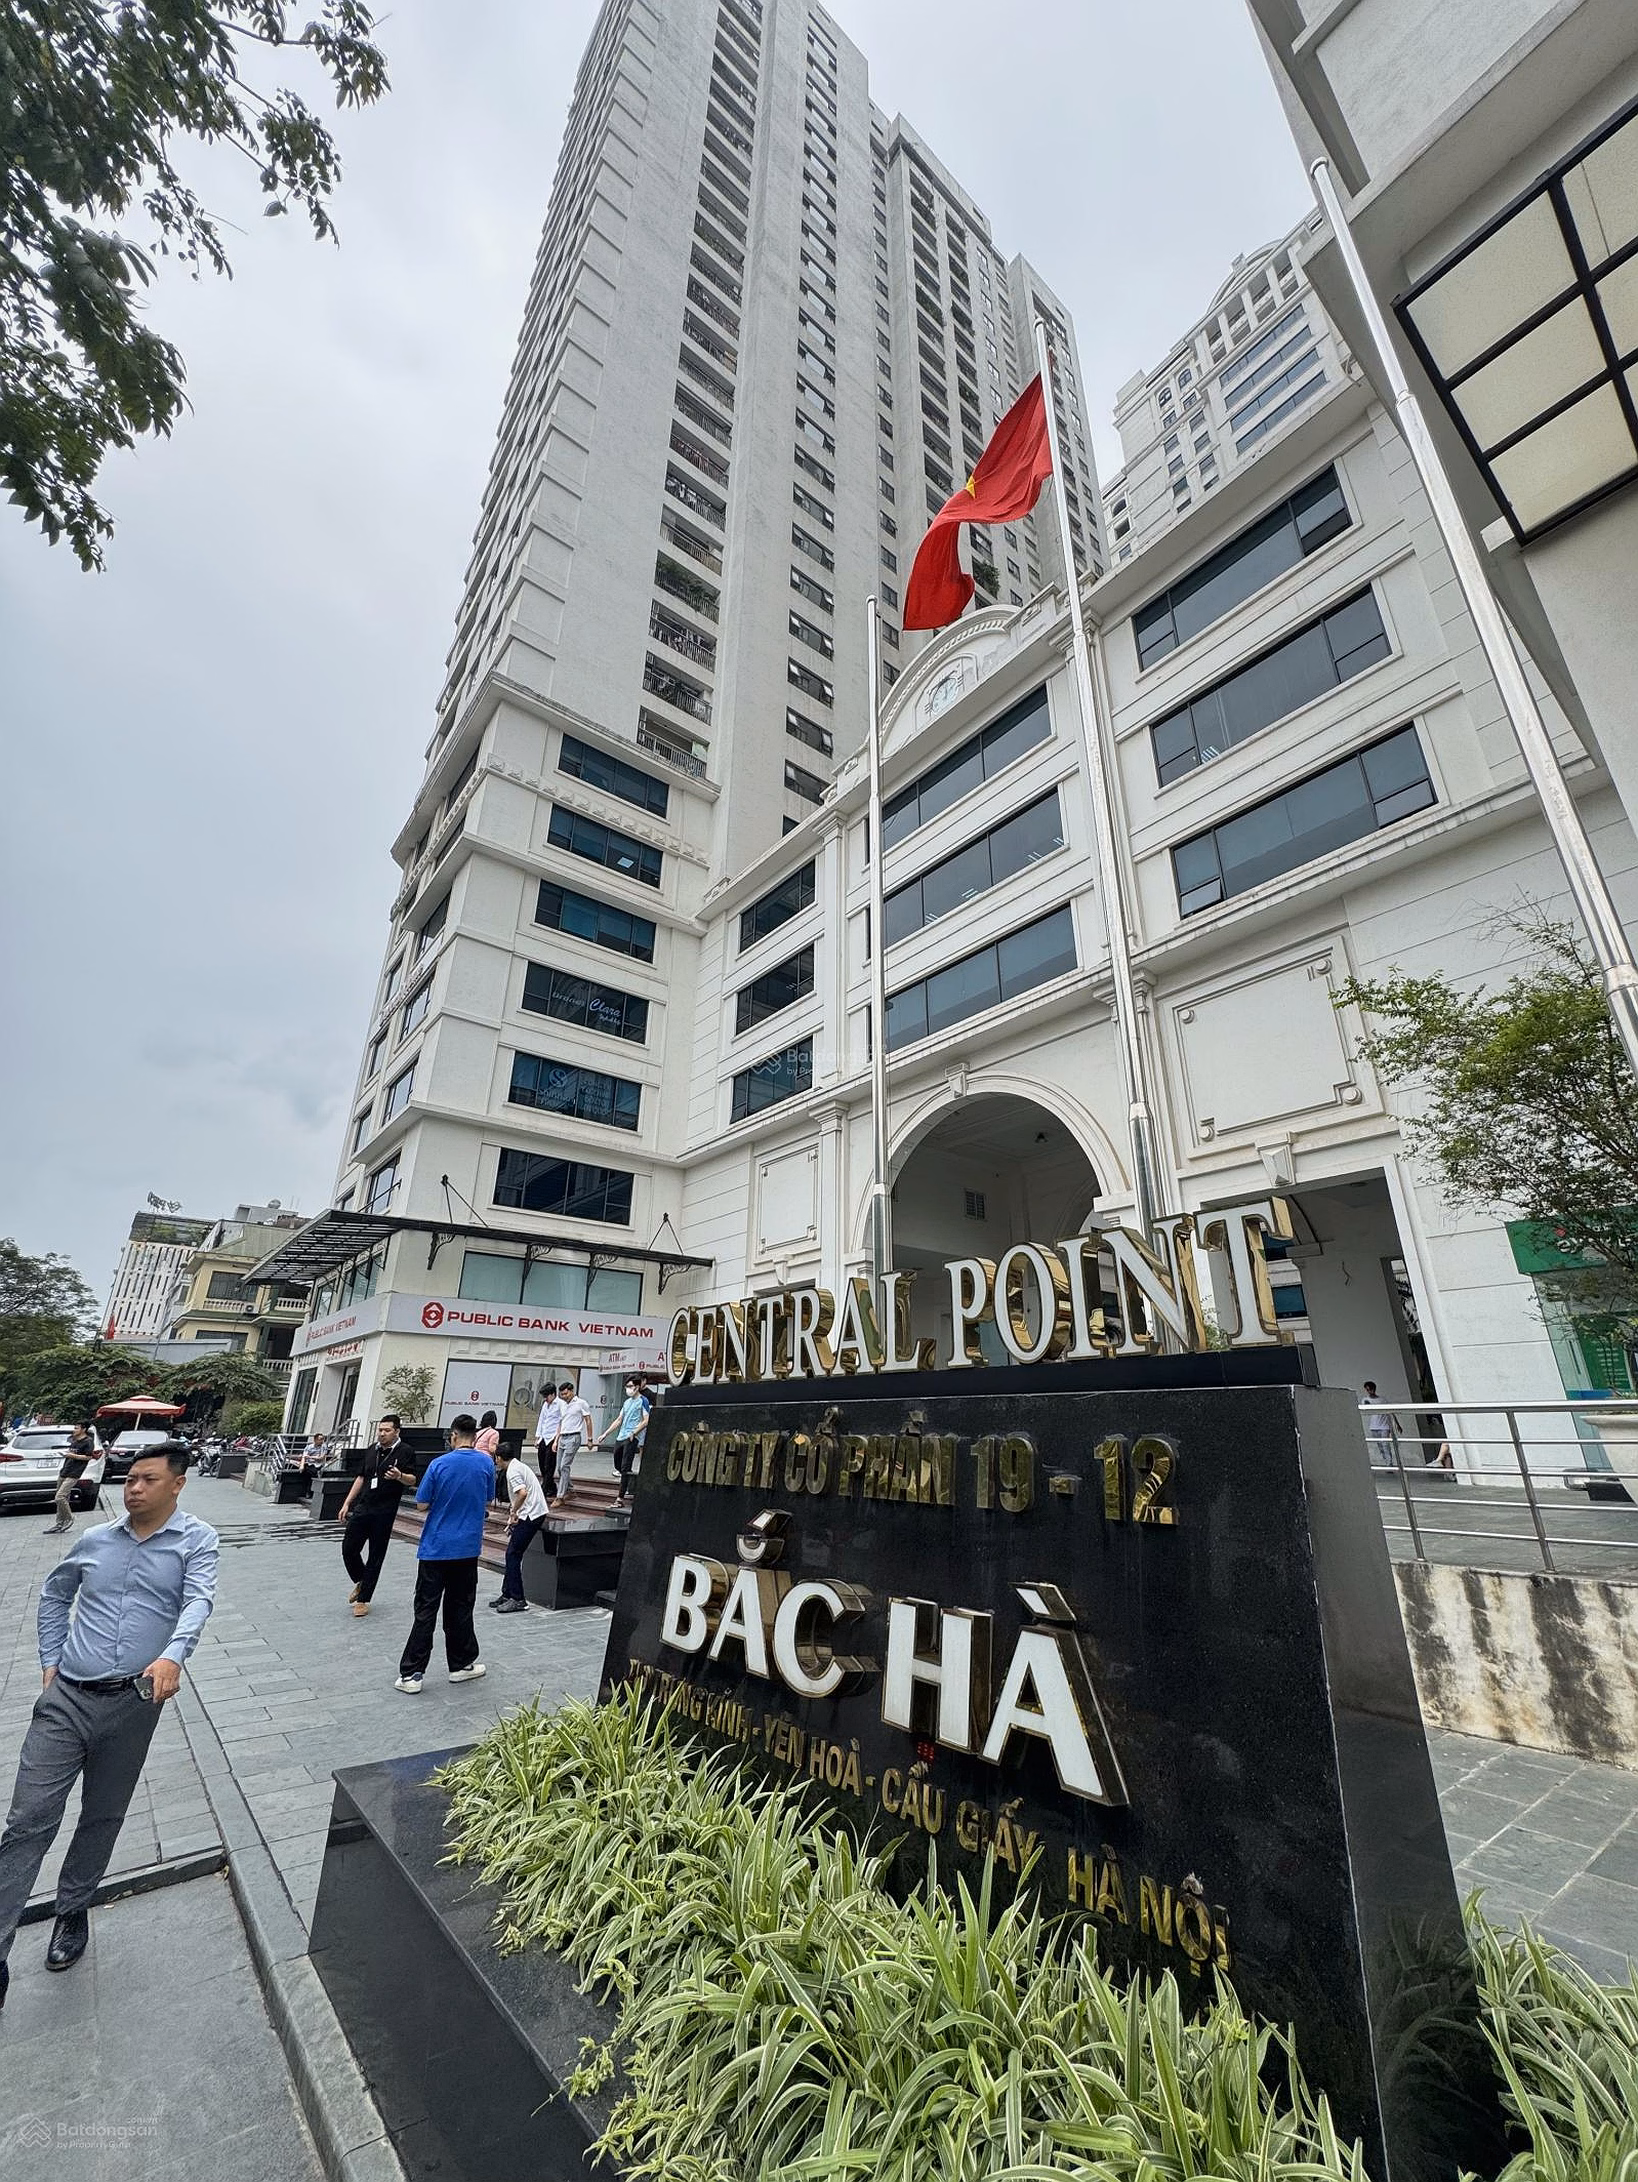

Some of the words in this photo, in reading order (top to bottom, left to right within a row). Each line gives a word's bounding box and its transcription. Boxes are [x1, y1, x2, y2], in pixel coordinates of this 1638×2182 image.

[447, 1310, 513, 1328] PUBLIC
[518, 1317, 570, 1332] BANK
[578, 1323, 654, 1339] VIETNAM
[608, 1351, 620, 1363] ATM
[666, 1270, 936, 1387] CENTRAL
[944, 1196, 1291, 1368] POINT
[668, 1420, 738, 1486] CÔNG
[741, 1431, 780, 1490] TY
[785, 1405, 839, 1496] CỔ
[839, 1410, 956, 1507] PHẦN
[970, 1433, 1035, 1514] 19
[1093, 1433, 1179, 1526] 12
[659, 1508, 877, 1699] BẮC
[880, 1581, 1129, 1807] HÀ
[763, 1711, 805, 1768] YÊN
[809, 1737, 864, 1797] HOÀ
[1067, 1843, 1130, 1926] HÀ
[1139, 1871, 1232, 1978] NỘI
